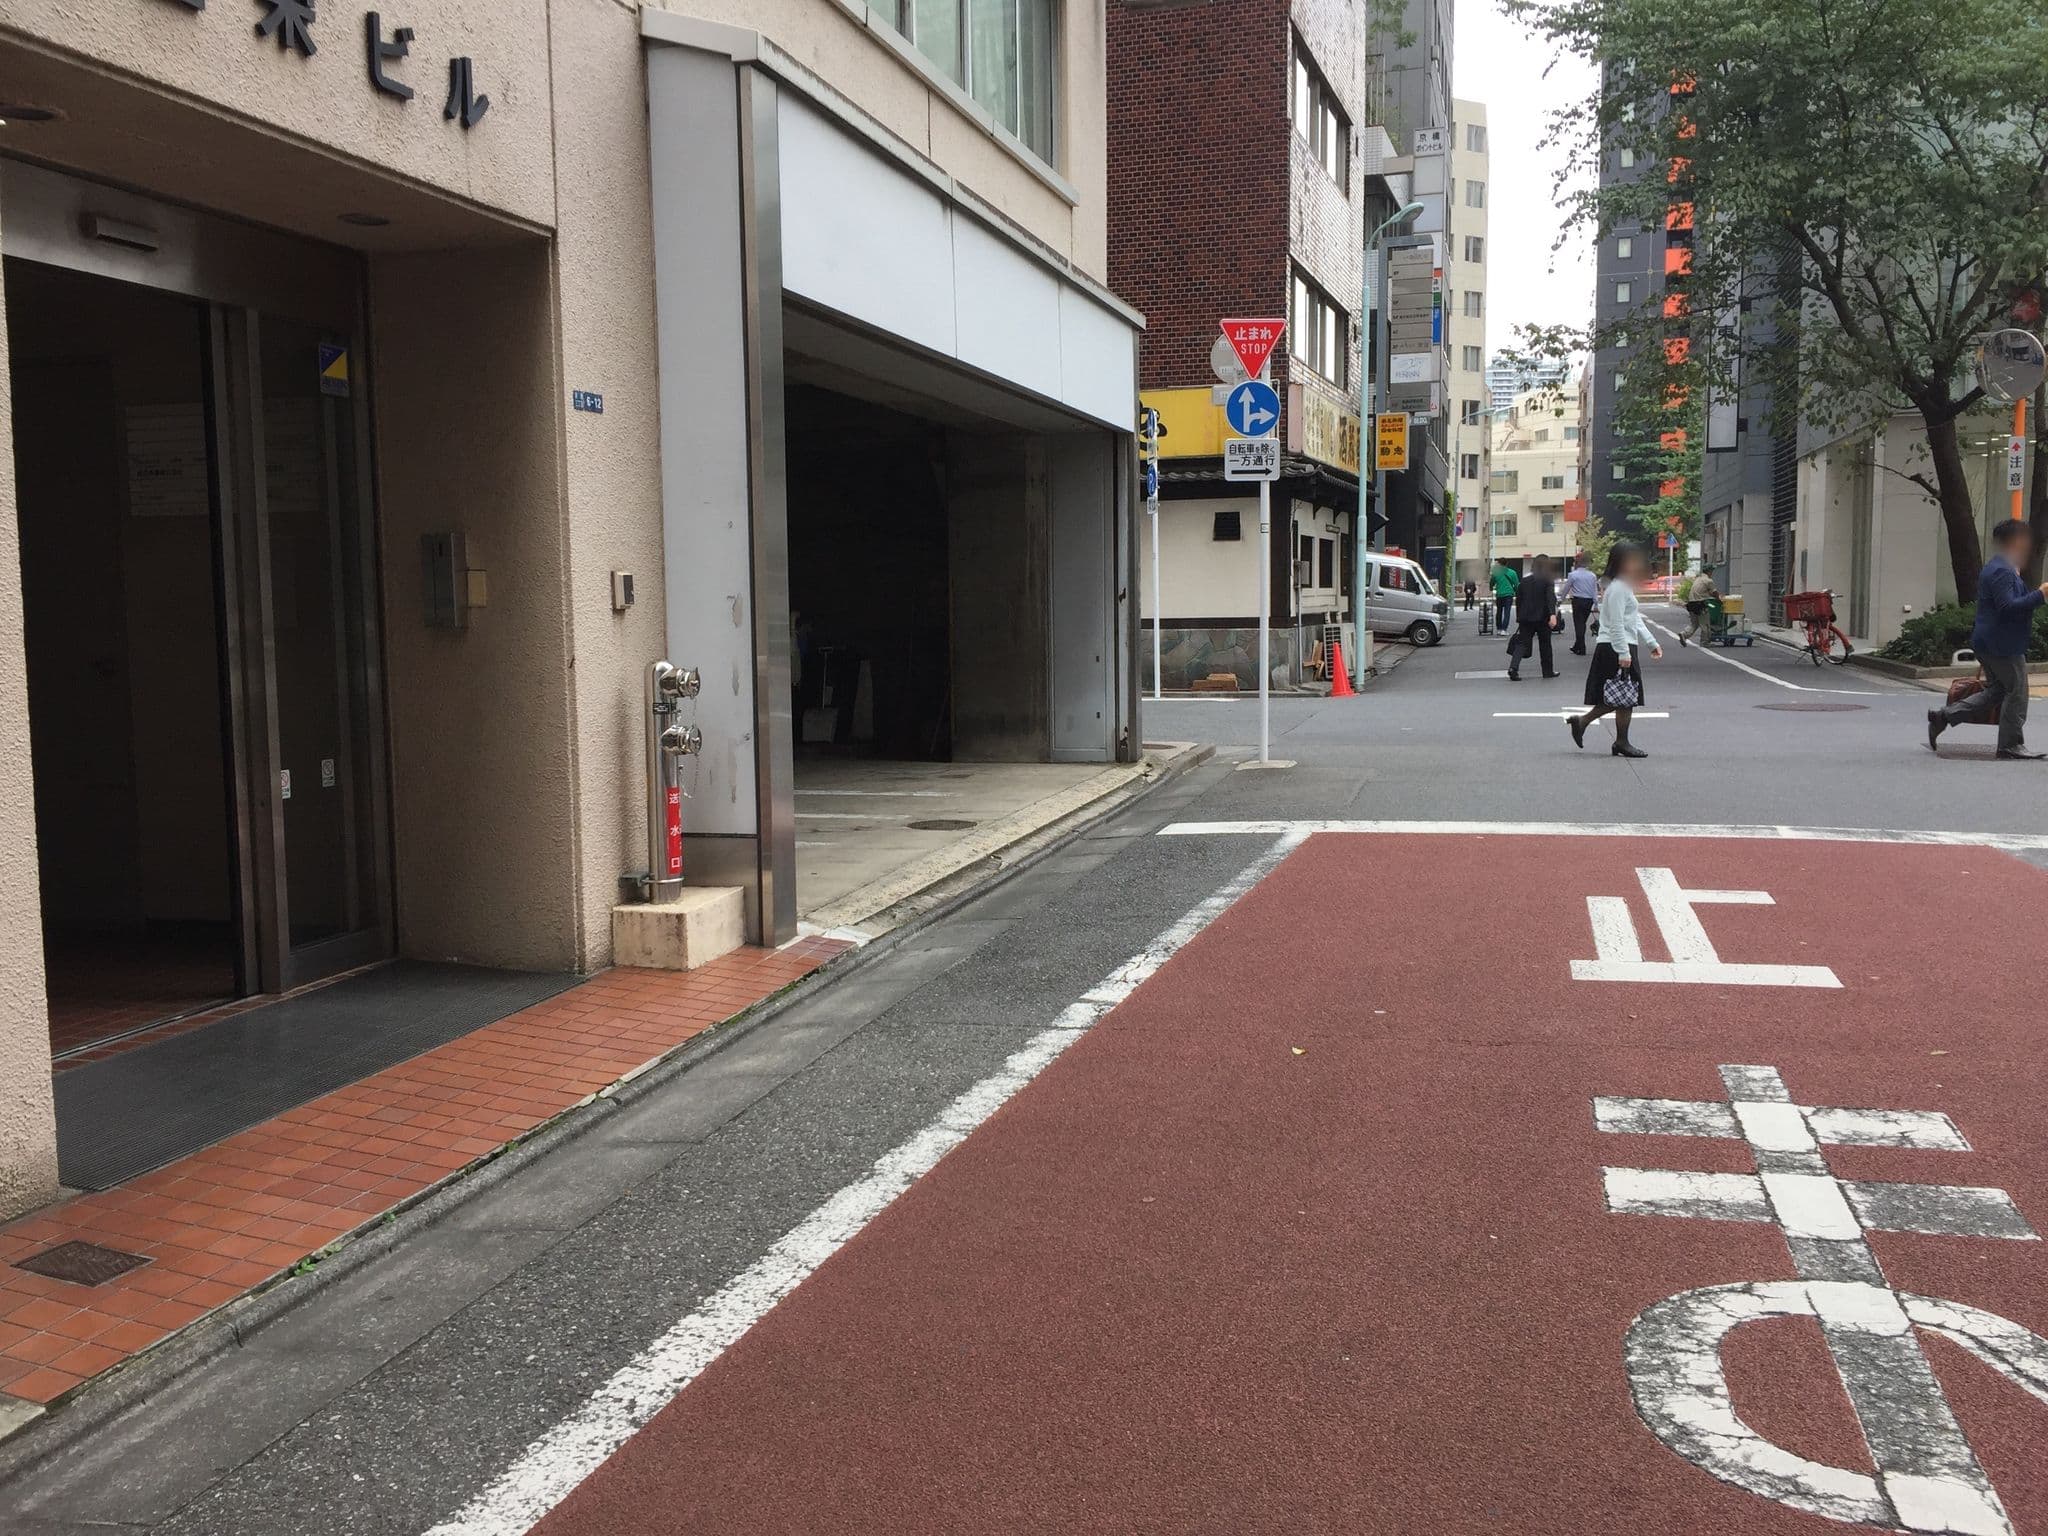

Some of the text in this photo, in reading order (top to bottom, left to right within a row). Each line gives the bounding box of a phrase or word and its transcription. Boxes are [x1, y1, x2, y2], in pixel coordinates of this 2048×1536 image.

[1234, 327, 1273, 341] 止まれ
[1241, 343, 1267, 354] STOP
[1229, 444, 1275, 455] 自転車を除く
[1229, 455, 1275, 466] 一方通行
[2009, 455, 2023, 486] 注意
[669, 793, 680, 868] 送水口
